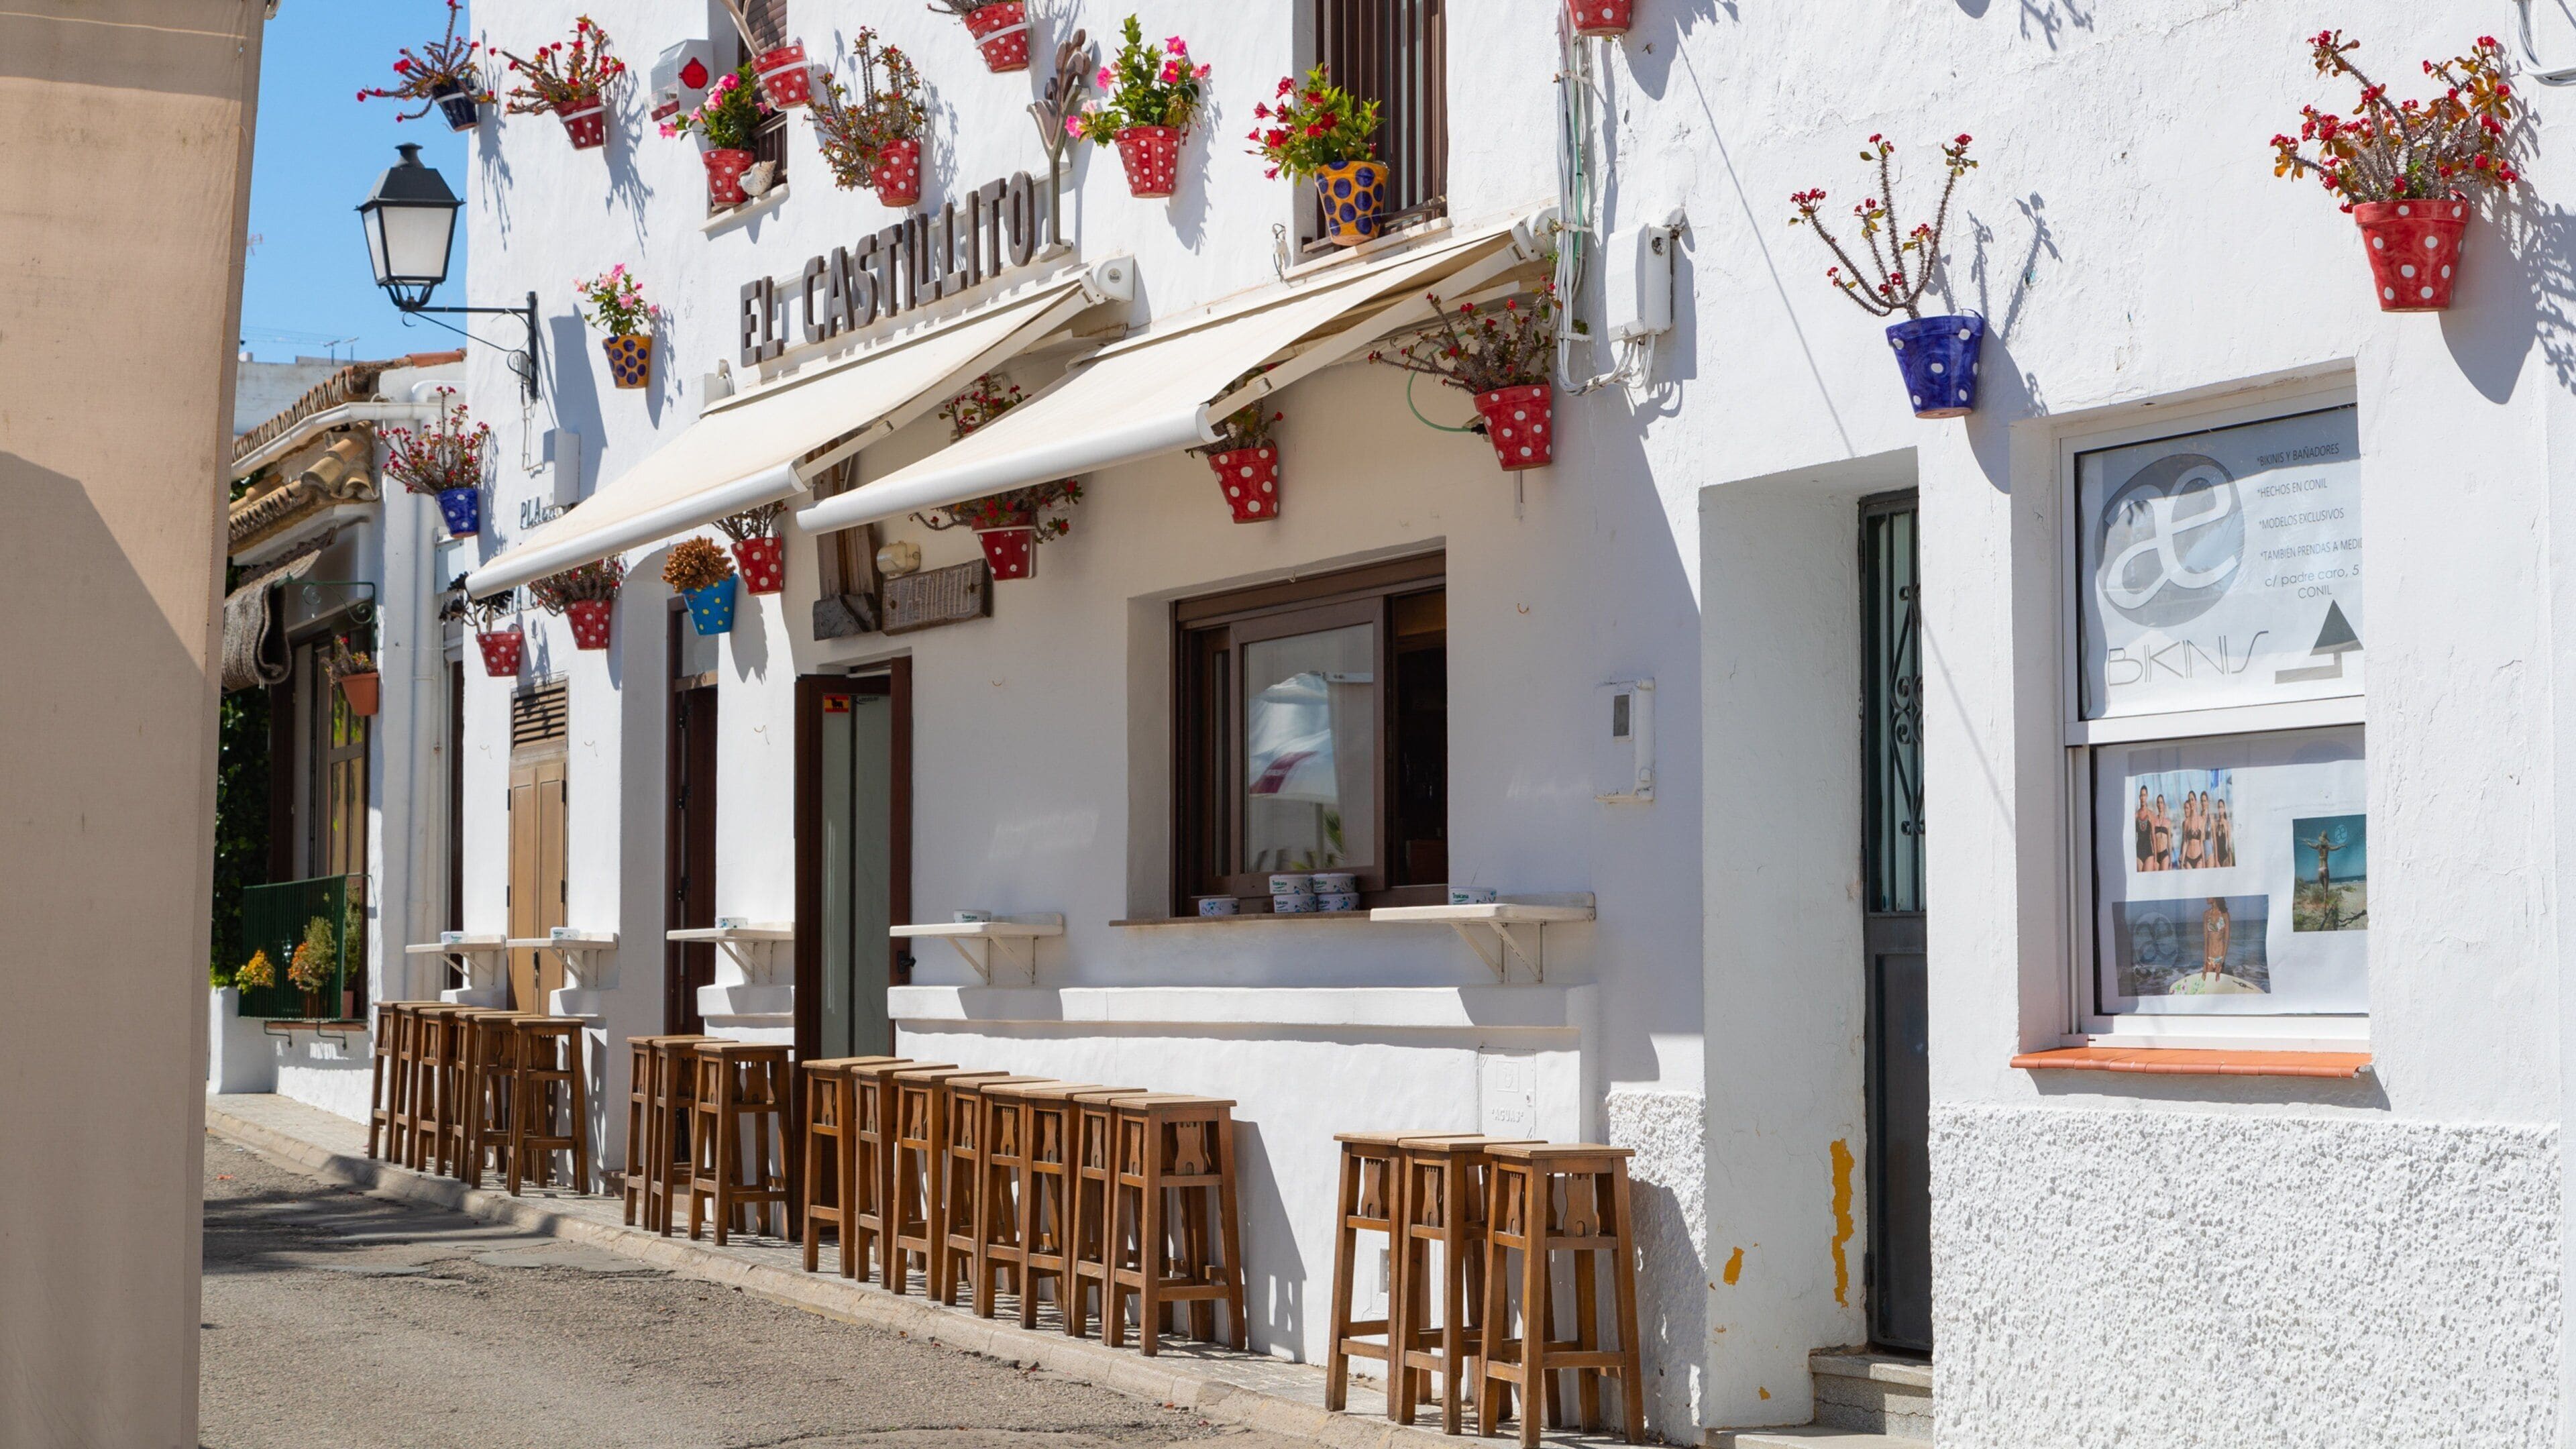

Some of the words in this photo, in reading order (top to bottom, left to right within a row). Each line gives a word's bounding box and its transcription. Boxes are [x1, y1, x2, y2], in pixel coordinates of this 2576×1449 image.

[741, 276, 784, 368] EL
[802, 170, 1035, 345] CASTILLITO
[2286, 451, 2291, 462] Y
[2292, 443, 2340, 461] BAÑADORES
[2292, 482, 2302, 493] EN
[2304, 478, 2328, 491] CONIL
[2299, 507, 2345, 524] EXCLUSIVOS
[2298, 541, 2331, 557] PRENDAS
[2332, 541, 2339, 552] A
[2264, 575, 2277, 588] c/
[2281, 571, 2315, 588] padre
[2318, 568, 2349, 580] caro,
[2352, 564, 2360, 576] 5
[902, 566, 973, 626] ASTILLITO
[2298, 584, 2333, 599] CONIL
[2108, 630, 2269, 687] BIKINIS
